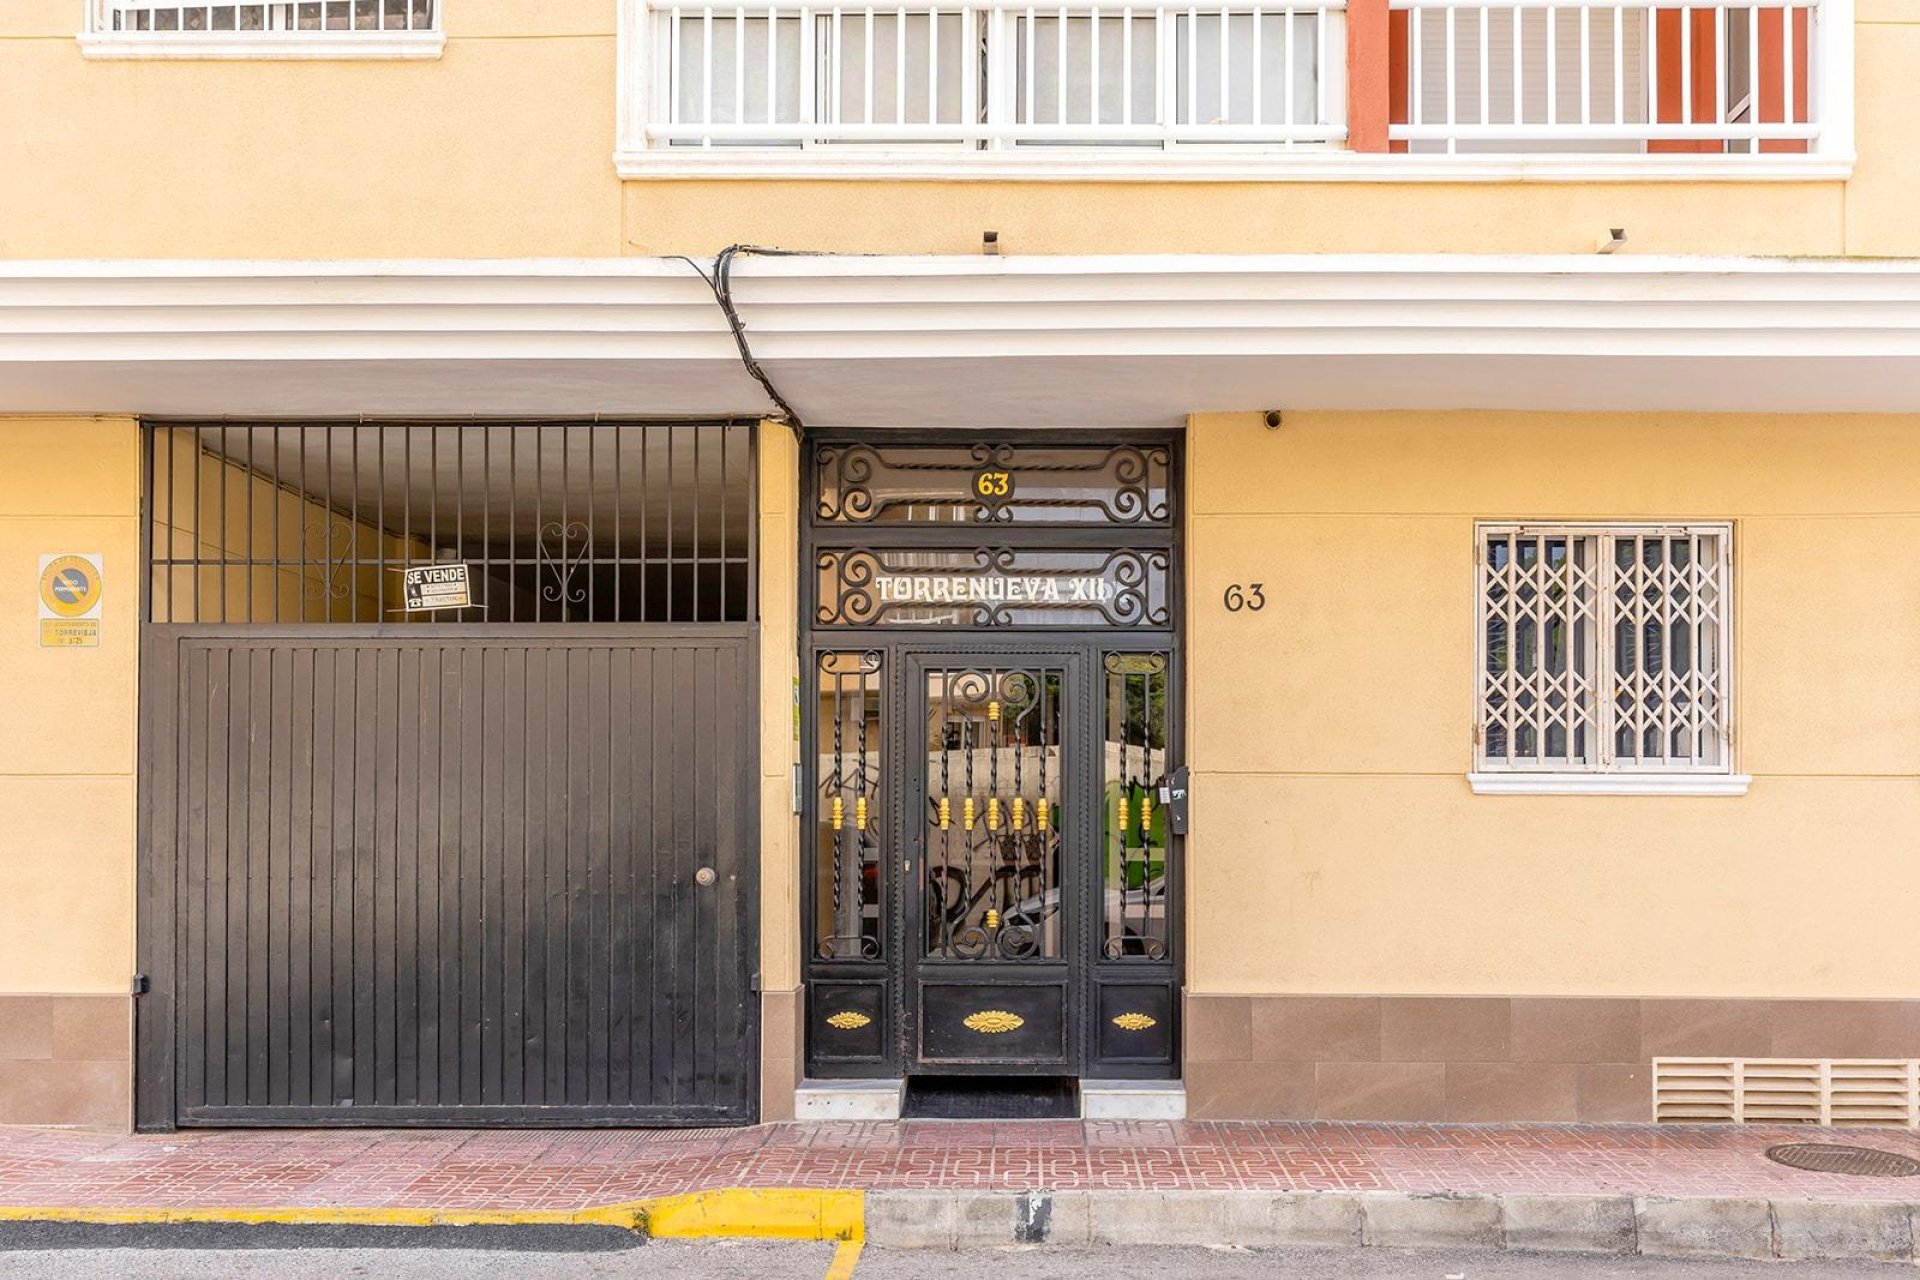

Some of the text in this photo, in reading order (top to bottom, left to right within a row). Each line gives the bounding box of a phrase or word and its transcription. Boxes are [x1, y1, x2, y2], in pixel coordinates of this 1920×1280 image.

[978, 472, 1009, 495] 63
[408, 568, 465, 584] SE VENDE
[875, 577, 1060, 601] TORRENUEVA
[1223, 583, 1266, 612] 63
